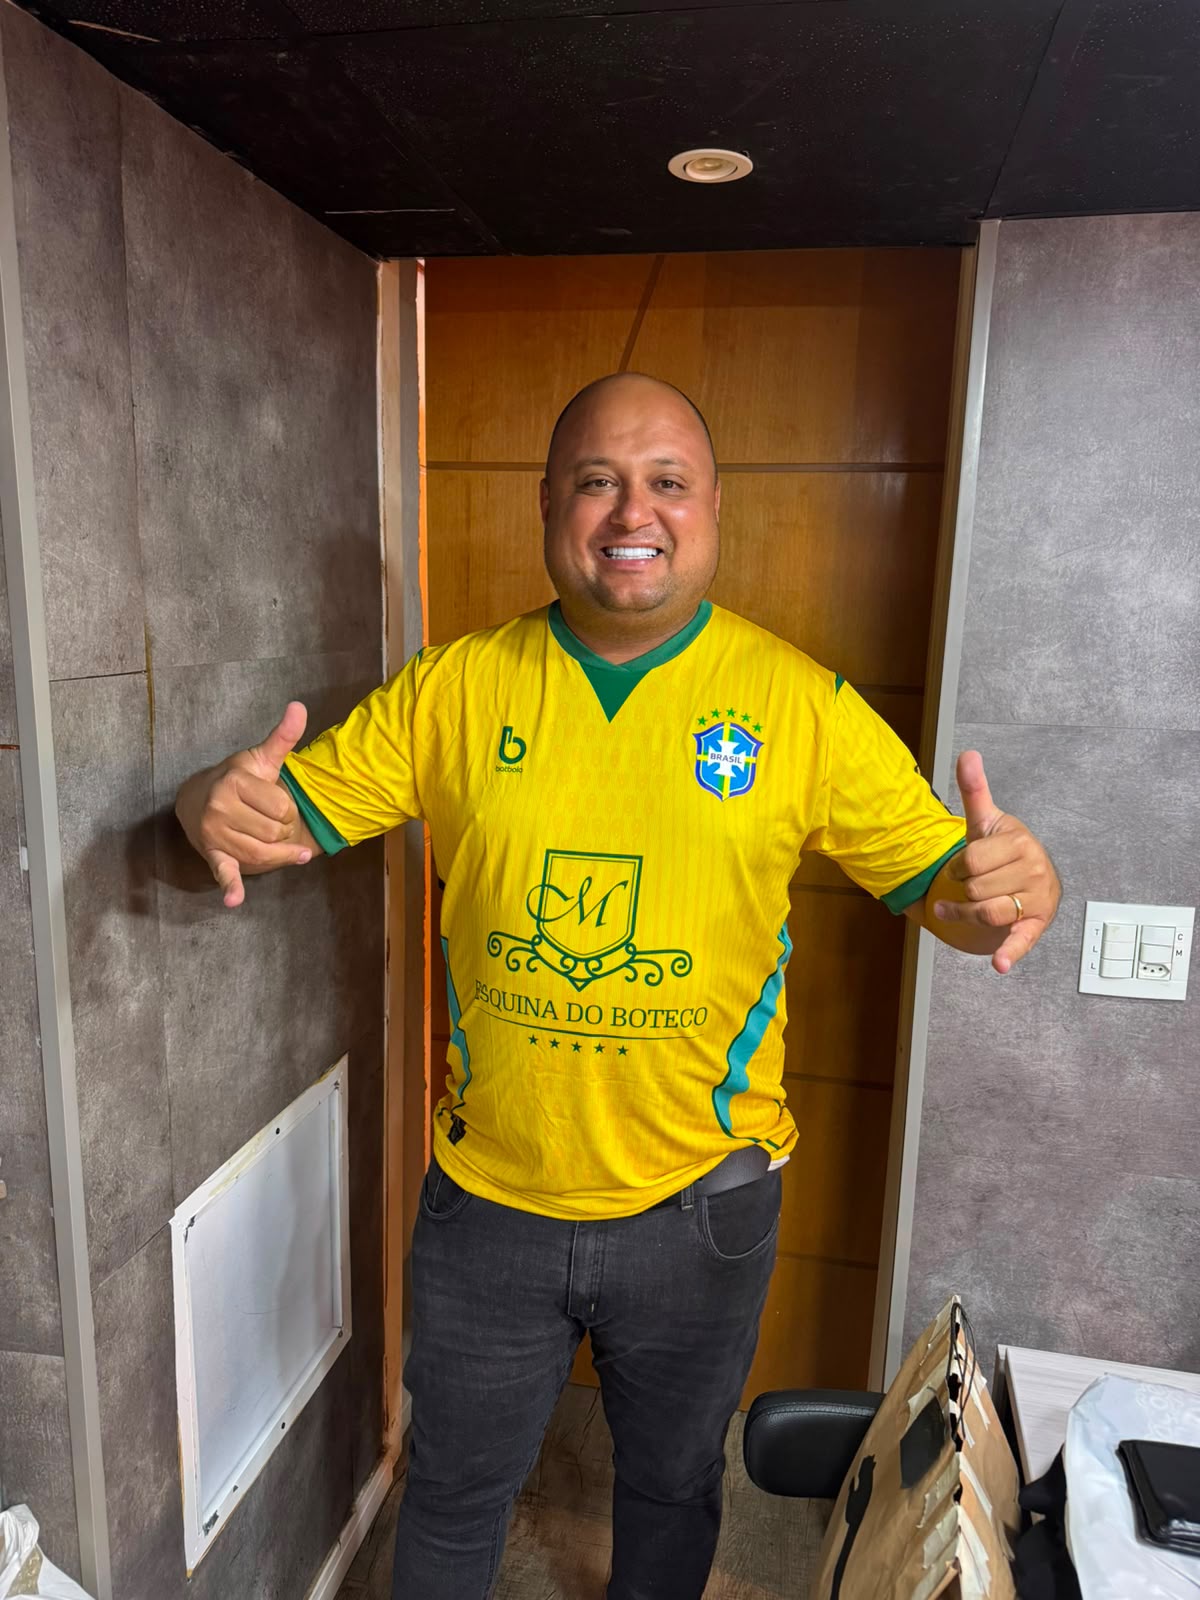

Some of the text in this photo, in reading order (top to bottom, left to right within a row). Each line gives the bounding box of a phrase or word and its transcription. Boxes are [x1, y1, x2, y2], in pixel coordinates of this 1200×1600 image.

[710, 752, 743, 764] BRASIL
[526, 875, 629, 928] M
[1094, 928, 1100, 936] T
[1177, 933, 1184, 941] C
[1092, 945, 1098, 953] L
[1090, 962, 1096, 970] L
[474, 978, 708, 1029] ESQUINA DO BOTECO
